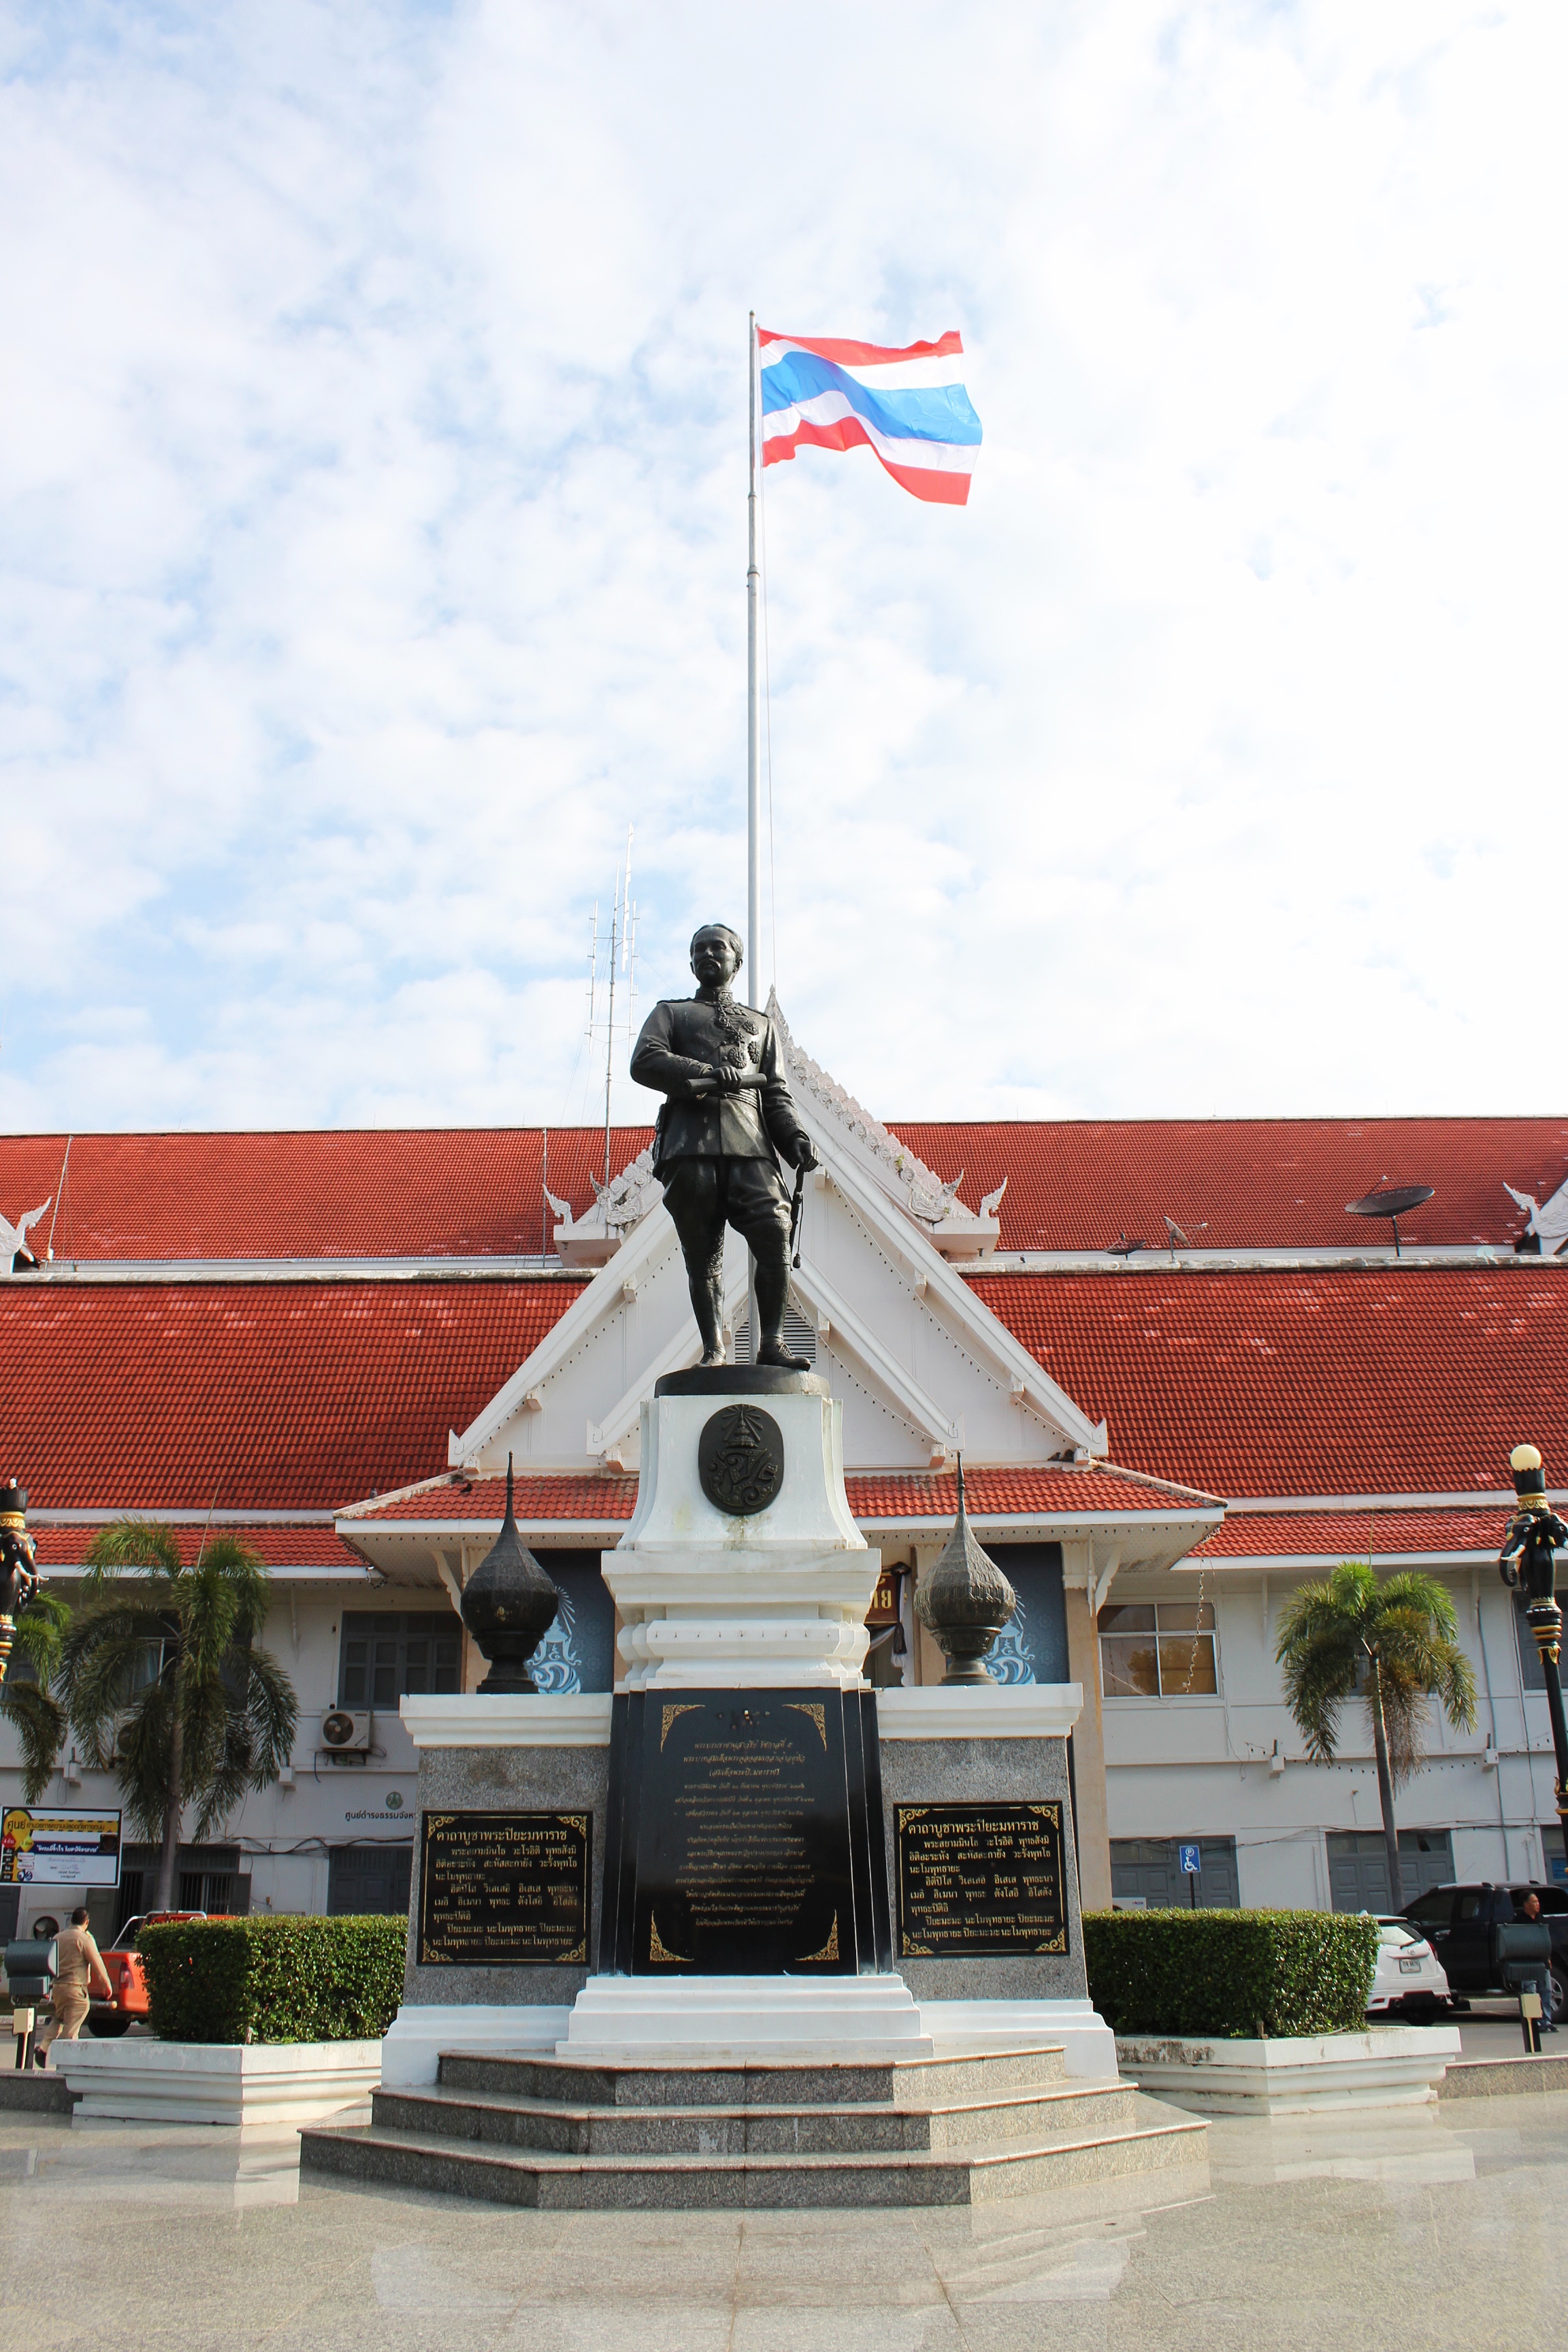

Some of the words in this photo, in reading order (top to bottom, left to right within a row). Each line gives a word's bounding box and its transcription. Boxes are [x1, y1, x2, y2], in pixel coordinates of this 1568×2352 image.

[345, 1810, 416, 1821] ศูนย์ดำรงธรรมจังห
[7, 1819, 27, 1832] ศูนย์
[908, 1818, 1039, 1838] คาถาบูชาพระปิยะมหาราช
[437, 1827, 567, 1846] คาถาบูชาพระปิยะมหาราช
[512, 1844, 540, 1855] วะโรอิติ
[909, 1850, 949, 1861] อิติอะระหัง
[1013, 1846, 1051, 1861] วะรังพุทโธ
[484, 1857, 532, 1867] สะหัสสะกายัง
[539, 1857, 577, 1870] วะรังพุทโธ
[909, 1863, 960, 1876] นะโมพุทธายะ
[436, 1870, 486, 1884] นะโมพุทธายะ
[926, 1875, 952, 1886] อิติปิโส
[958, 1874, 985, 1885] วิเสเสอิ
[994, 1874, 1017, 1884] อิเสเส
[1023, 1875, 1053, 1886] พุทธะนา
[483, 1883, 510, 1893] วิเสเสอิ
[519, 1883, 541, 1893] อิเสเส
[547, 1885, 578, 1895] พุทธะนา
[911, 1889, 924, 1899] เมอิ
[934, 1889, 958, 1899] อิเมนา
[965, 1890, 987, 1901] พุทธะ
[994, 1886, 1019, 1897] ตังโสอิ
[1028, 1886, 1052, 1897] อิโสตัง
[434, 1896, 448, 1906] เมอิ
[457, 1896, 481, 1906] อิเมนา
[489, 1898, 510, 1908] พุทธะ
[518, 1895, 542, 1906] ตังโสอิ
[553, 1895, 577, 1906] อิโสตัง
[911, 1902, 949, 1916] พุทธะปิติอิ
[433, 1910, 471, 1924] พุทธะปิติอิ
[926, 1915, 962, 1925] ปิยะมะมะ
[965, 1913, 1015, 1927] นะโมพุทธายะ
[1017, 1913, 1054, 1923] ปิยะมะมะ
[447, 1923, 483, 1933] ปิยะมะมะ
[487, 1922, 537, 1936] นะโมพุทธายะ
[539, 1923, 576, 1933] ปิยะมะมะ
[912, 1927, 962, 1942] นะโมพุทธายะ
[963, 1927, 1000, 1938] ปิยะมะมะ
[1001, 1925, 1051, 1939] นะโมพุทธายะ
[432, 1935, 483, 1949] นะโมพุทธายะ
[484, 1936, 520, 1946] ปิยะมะมะ
[522, 1934, 573, 1948] นะโมพุทธายะ
